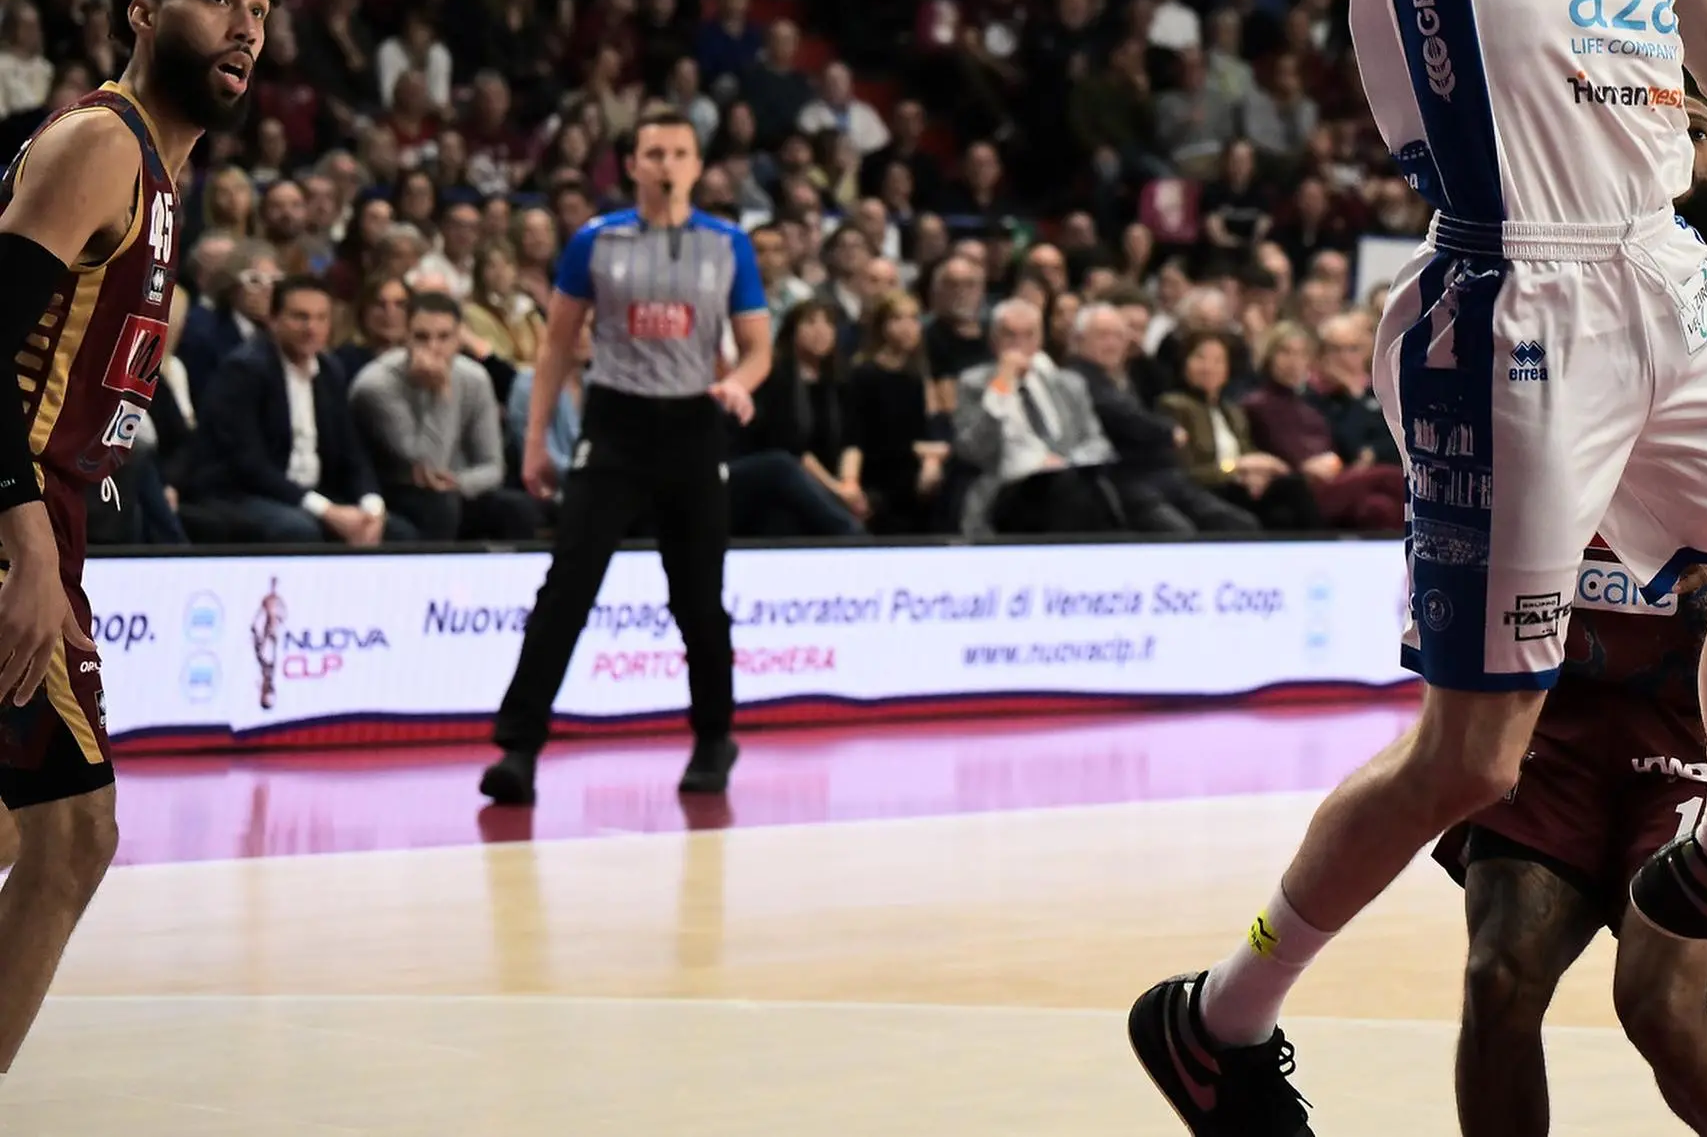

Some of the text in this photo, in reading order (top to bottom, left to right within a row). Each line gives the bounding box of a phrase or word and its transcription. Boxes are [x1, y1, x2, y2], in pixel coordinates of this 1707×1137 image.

[1571, 38, 1678, 60] LIFE COMPANY
[148, 190, 174, 264] 45
[424, 600, 530, 634] Nuova
[891, 586, 1001, 624] Portuali
[1044, 585, 1144, 617] Venezia
[284, 627, 390, 651] NUOVA
